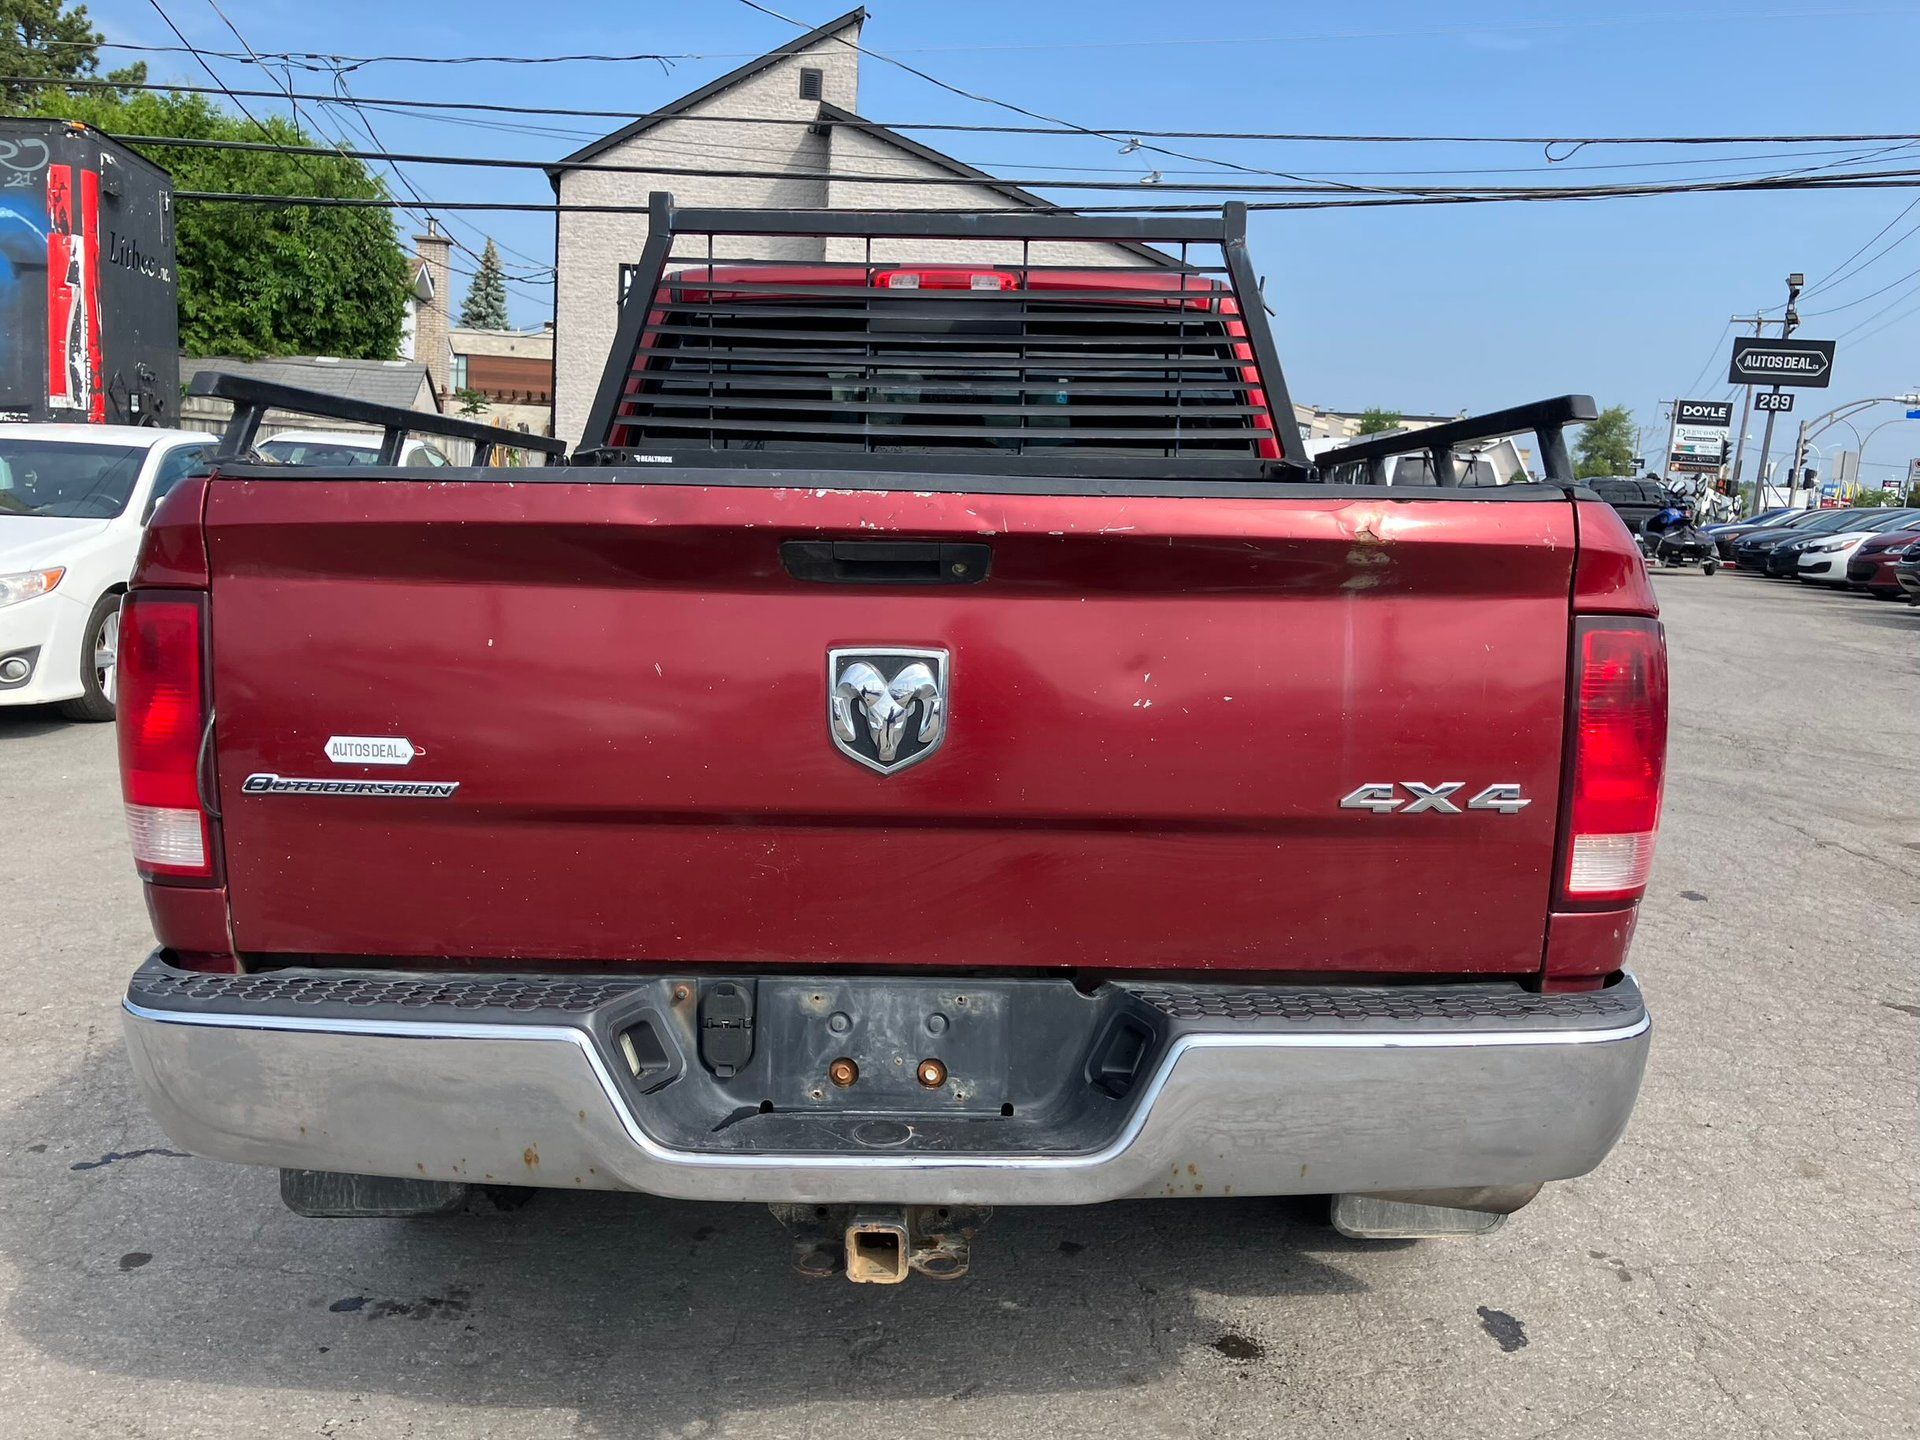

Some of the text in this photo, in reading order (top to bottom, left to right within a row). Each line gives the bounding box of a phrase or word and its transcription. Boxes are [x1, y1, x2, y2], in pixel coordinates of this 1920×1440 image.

[1759, 394, 1791, 409] 289
[1682, 405, 1727, 417] DOYLE
[1340, 781, 1532, 814] 4X4
